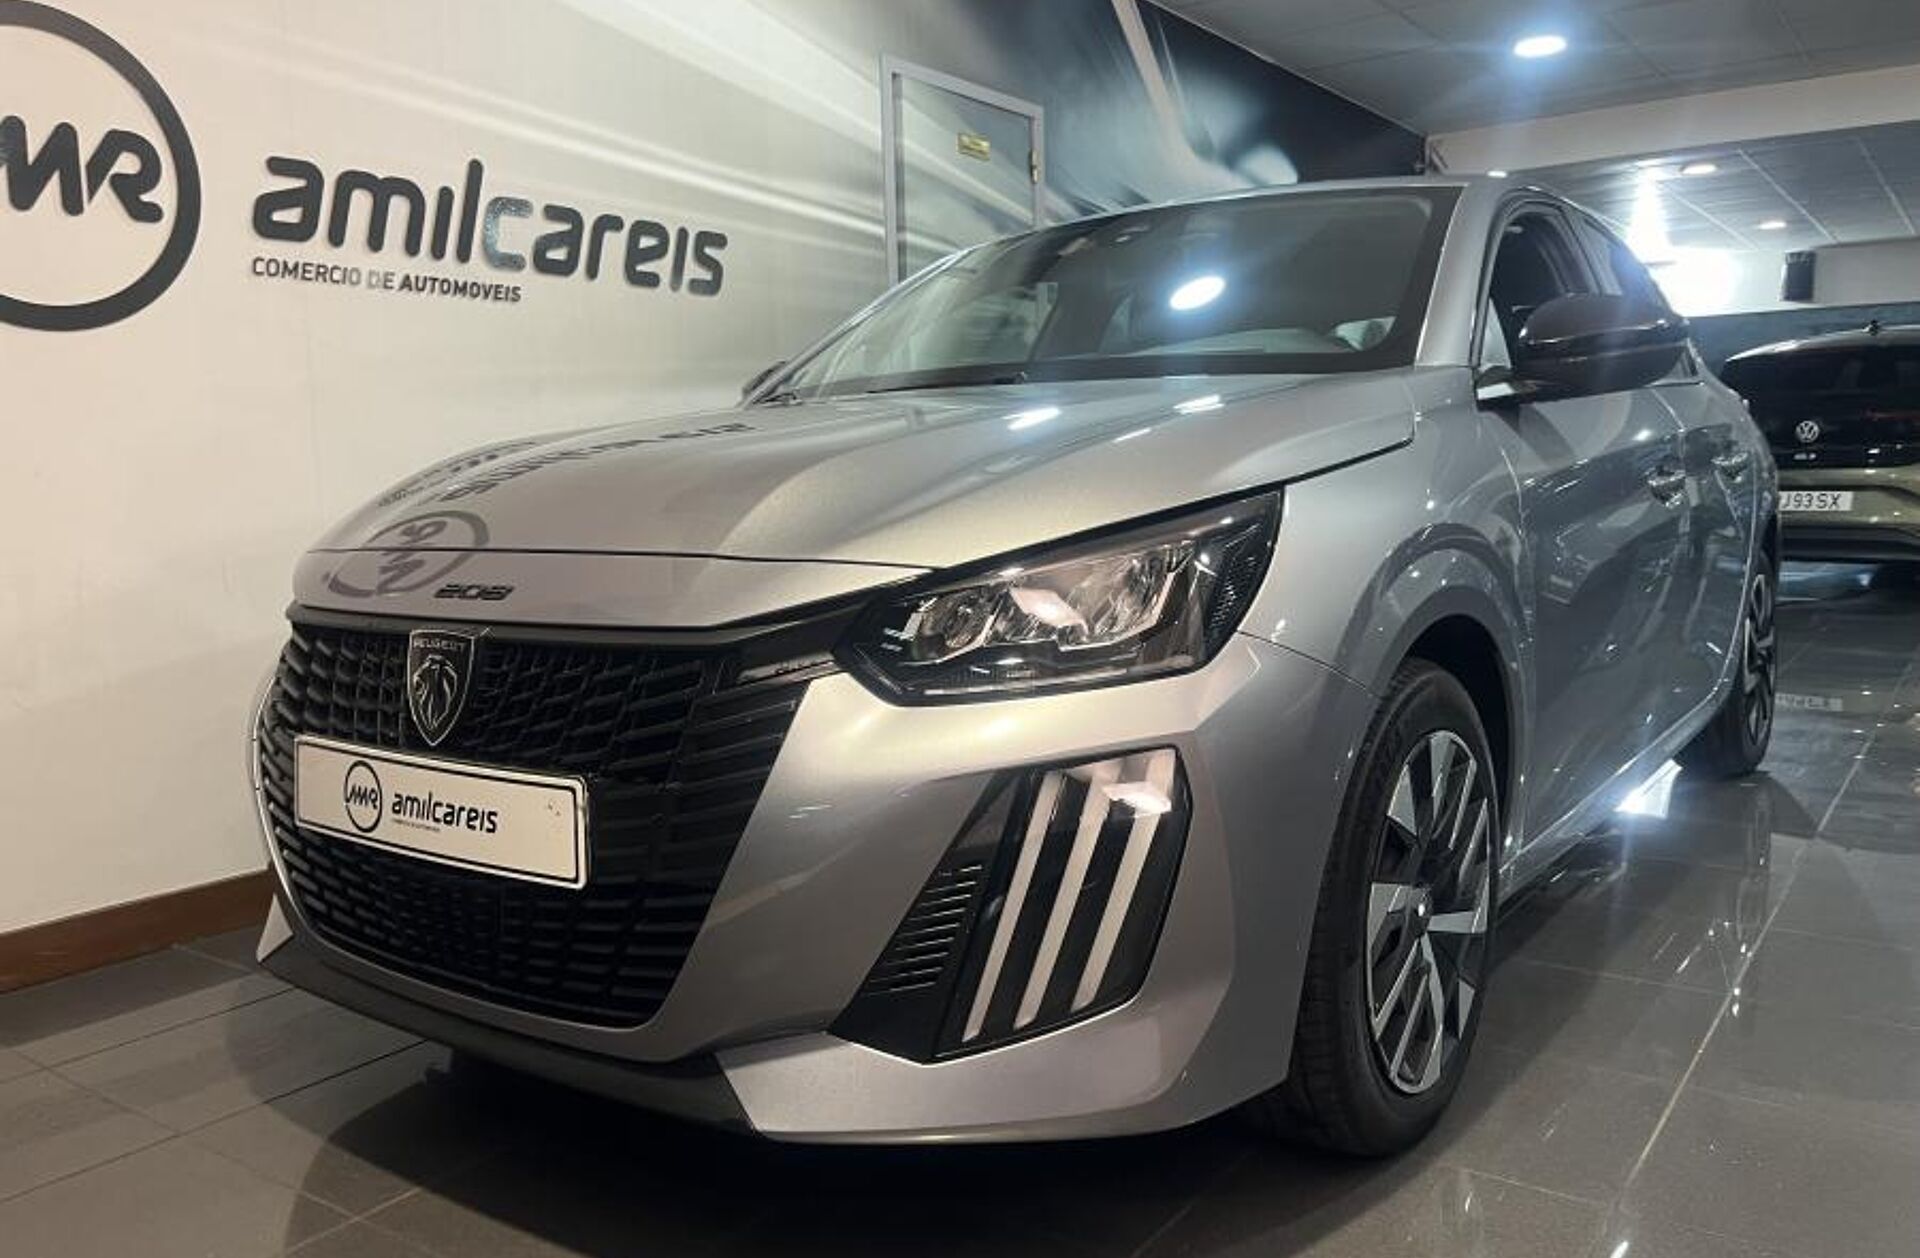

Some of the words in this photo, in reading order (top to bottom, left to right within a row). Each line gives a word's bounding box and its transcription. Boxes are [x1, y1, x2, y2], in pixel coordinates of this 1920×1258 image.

[252, 156, 728, 297] amilcareis
[252, 256, 362, 286] COMERCIO
[366, 269, 396, 290] DE
[399, 273, 521, 302] AUTOMOVEIS
[434, 584, 515, 601] 208
[413, 637, 466, 653] PEUGEOT
[391, 790, 498, 834] amilcareis
